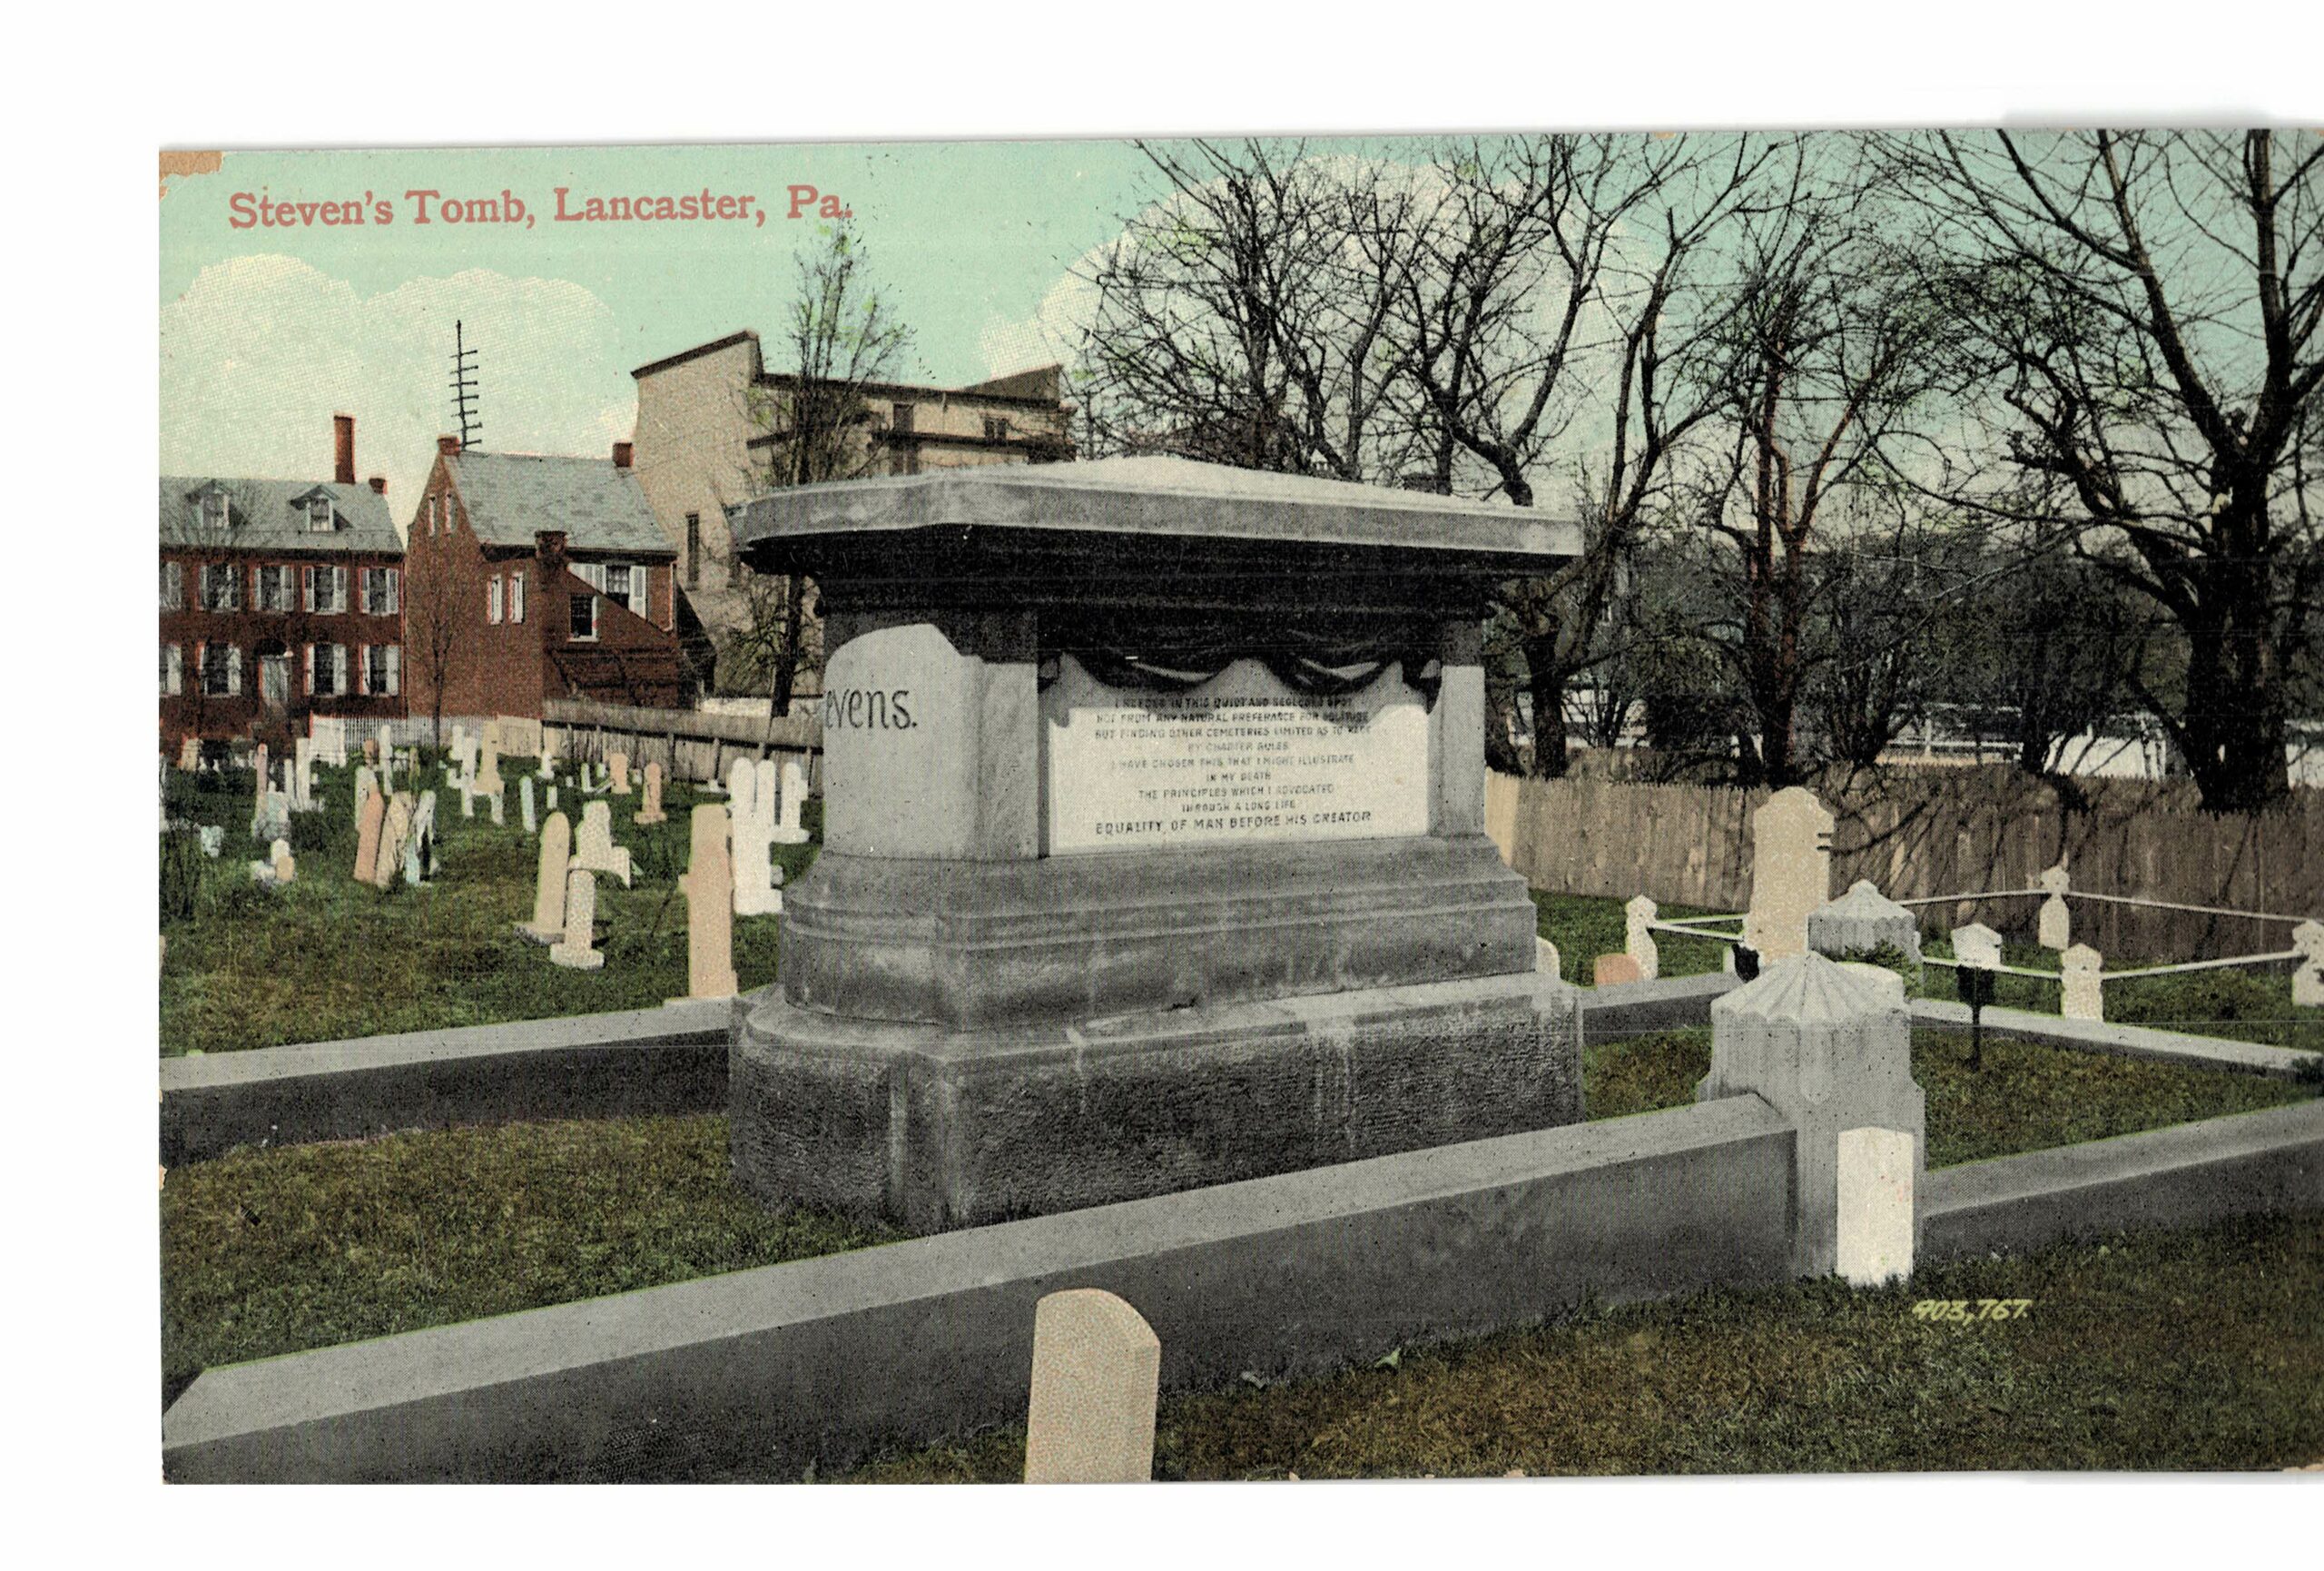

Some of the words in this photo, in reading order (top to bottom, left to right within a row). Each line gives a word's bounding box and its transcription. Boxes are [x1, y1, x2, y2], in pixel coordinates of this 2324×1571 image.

[1181, 712, 1228, 723] NATURAL
[1120, 728, 1166, 739] FINDING
[1138, 789, 1158, 801] THE
[1163, 787, 1227, 800] PRINCIPLES
[1230, 786, 1265, 797] WHICH
[1095, 819, 1163, 836] EQUALITY
[1170, 818, 1188, 832] OF
[1194, 816, 1224, 831] MAN
[1229, 815, 1281, 829] BEFORE
[1285, 813, 1307, 827] HIS
[1312, 810, 1372, 825] CREATOR
